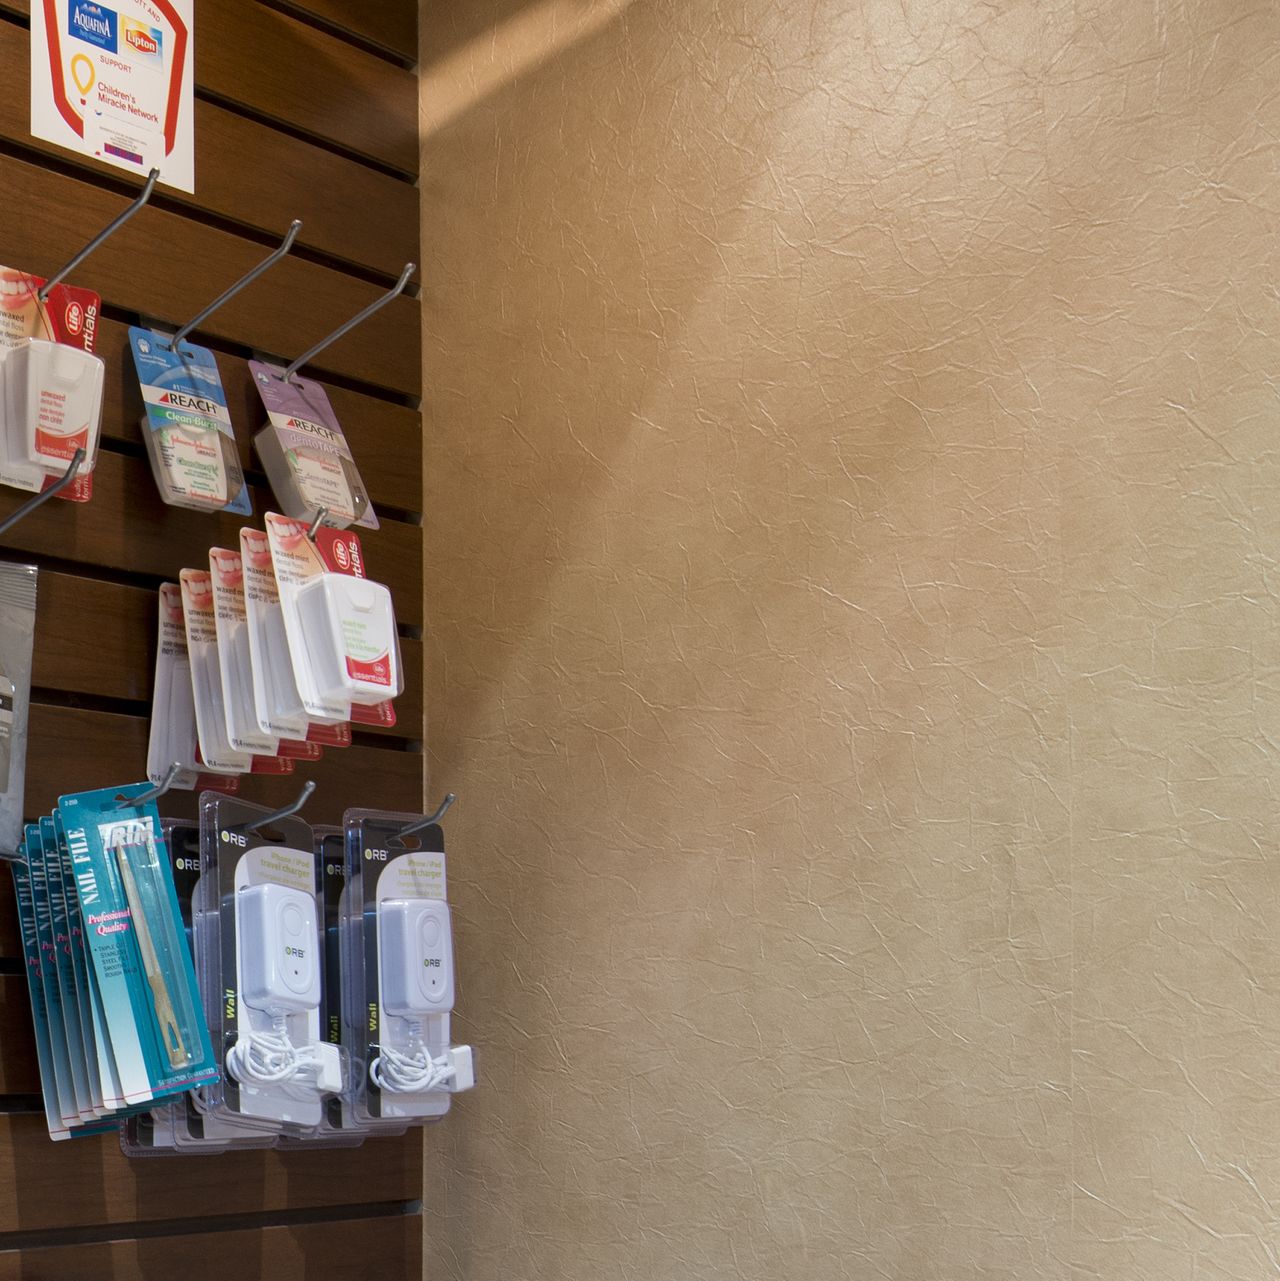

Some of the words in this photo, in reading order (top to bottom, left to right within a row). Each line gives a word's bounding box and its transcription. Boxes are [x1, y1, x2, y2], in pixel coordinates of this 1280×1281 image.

[74, 7, 112, 38] AQUAFINA
[126, 31, 157, 52] Lipton
[100, 55, 132, 74] SUPPORT
[97, 82, 137, 104] Children's
[98, 93, 127, 111] Miracle
[127, 104, 159, 124] Network
[68, 306, 81, 332] Life
[169, 393, 216, 414] REACH
[294, 419, 335, 441] REACH
[339, 540, 351, 569] Life
[66, 827, 92, 864] FILE
[74, 866, 101, 905] NAIL
[87, 906, 132, 925] Professional
[96, 920, 129, 936] Quality
[224, 988, 235, 1019] Wall
[368, 1002, 378, 1032] Wall
